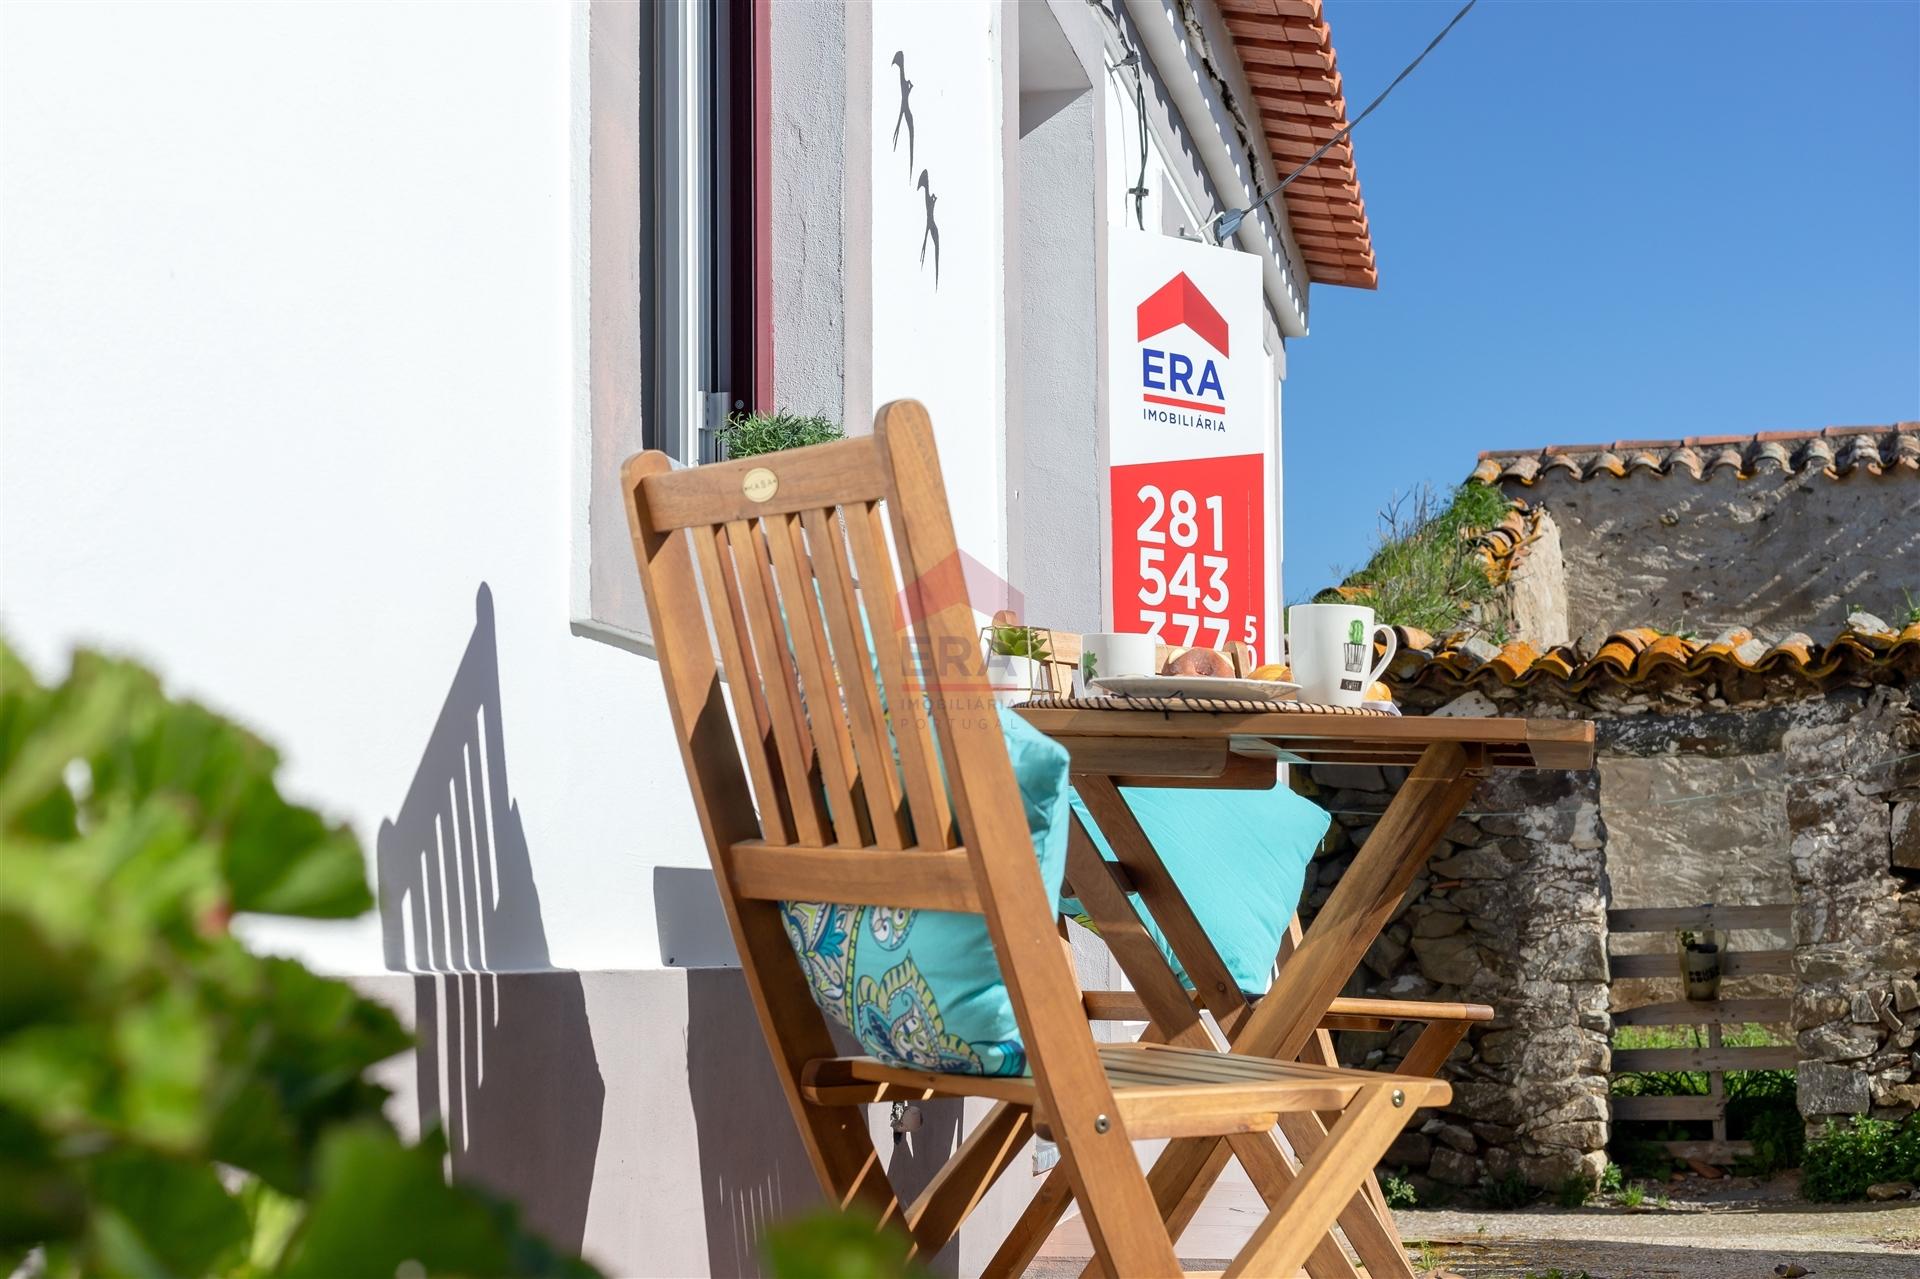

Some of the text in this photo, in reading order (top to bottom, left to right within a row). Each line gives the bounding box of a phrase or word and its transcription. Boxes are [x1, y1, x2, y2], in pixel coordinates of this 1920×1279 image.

[1143, 347, 1225, 401] ERA
[1143, 408, 1226, 432] IMOBILIÁRIA
[1137, 485, 1223, 552] 281
[1138, 547, 1230, 613] 543
